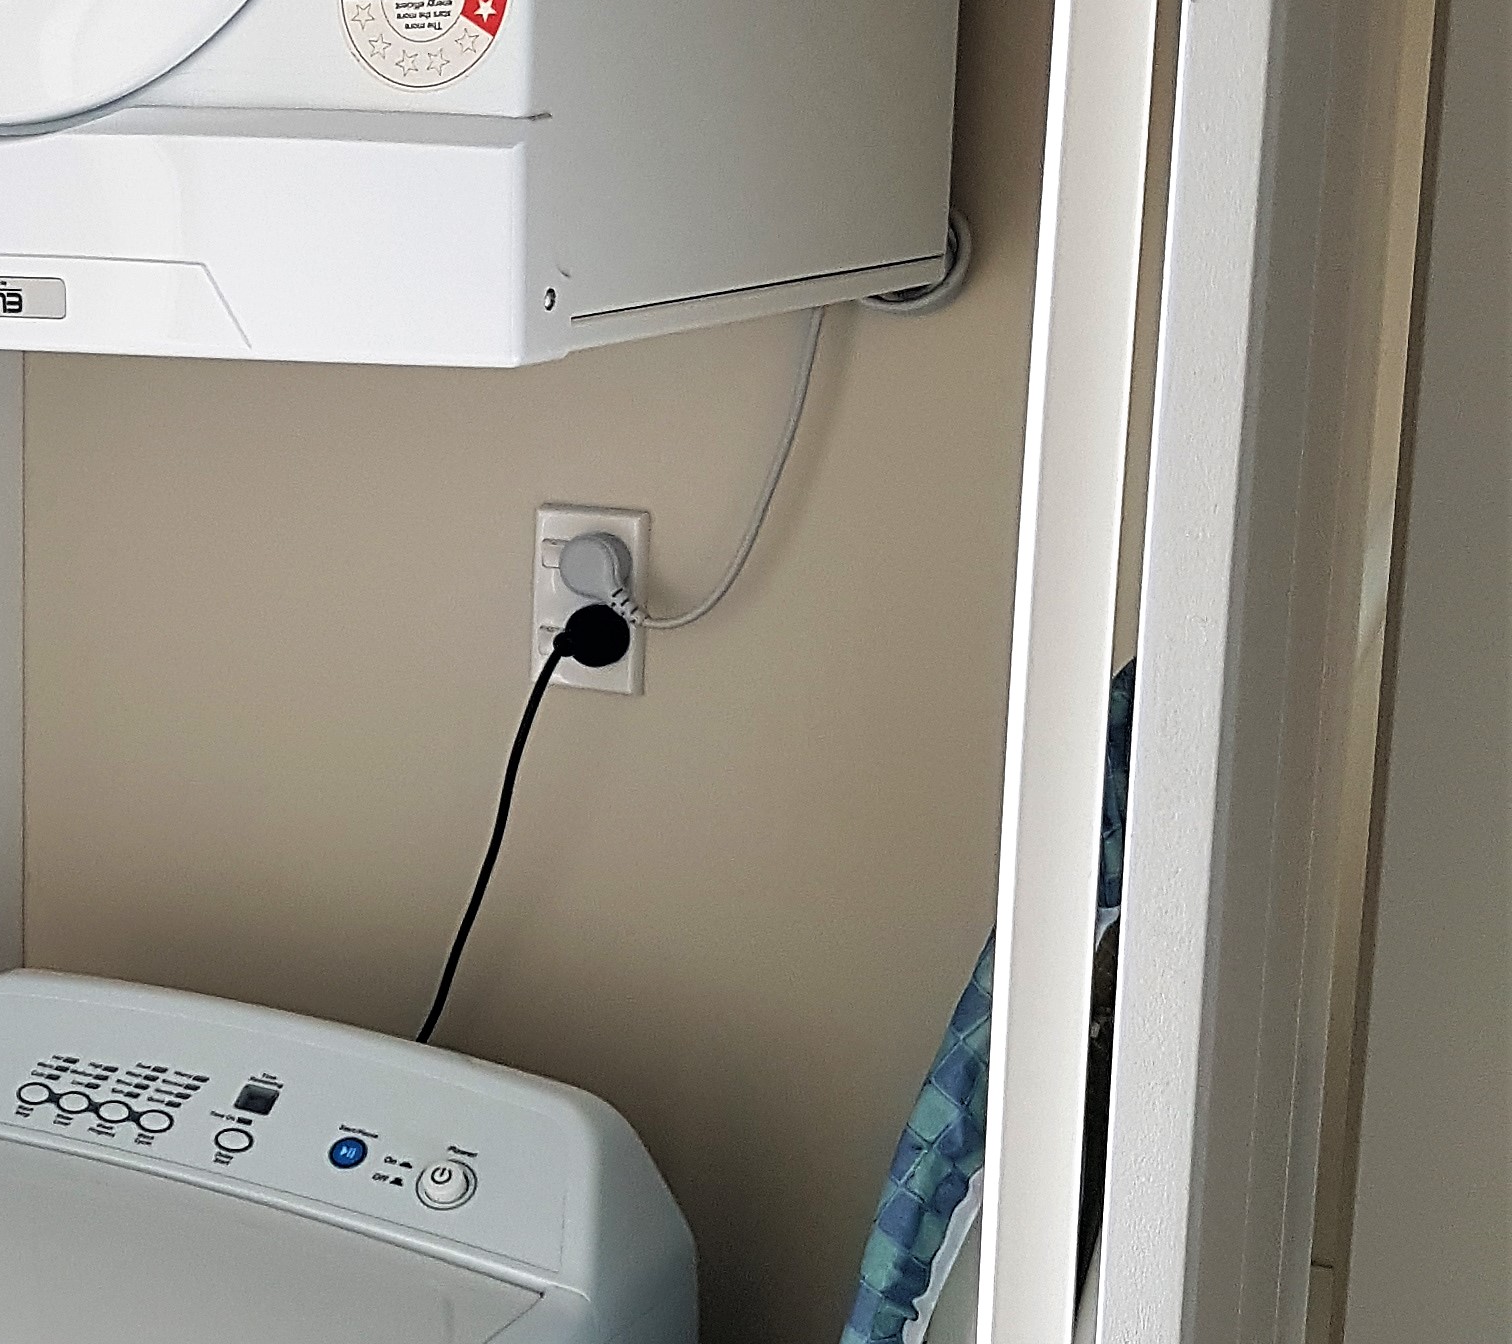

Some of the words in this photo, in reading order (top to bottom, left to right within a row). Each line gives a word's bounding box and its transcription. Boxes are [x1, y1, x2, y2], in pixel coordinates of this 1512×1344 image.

[396, 12, 417, 20] more
[404, 22, 426, 31] more
[427, 21, 443, 31] The
